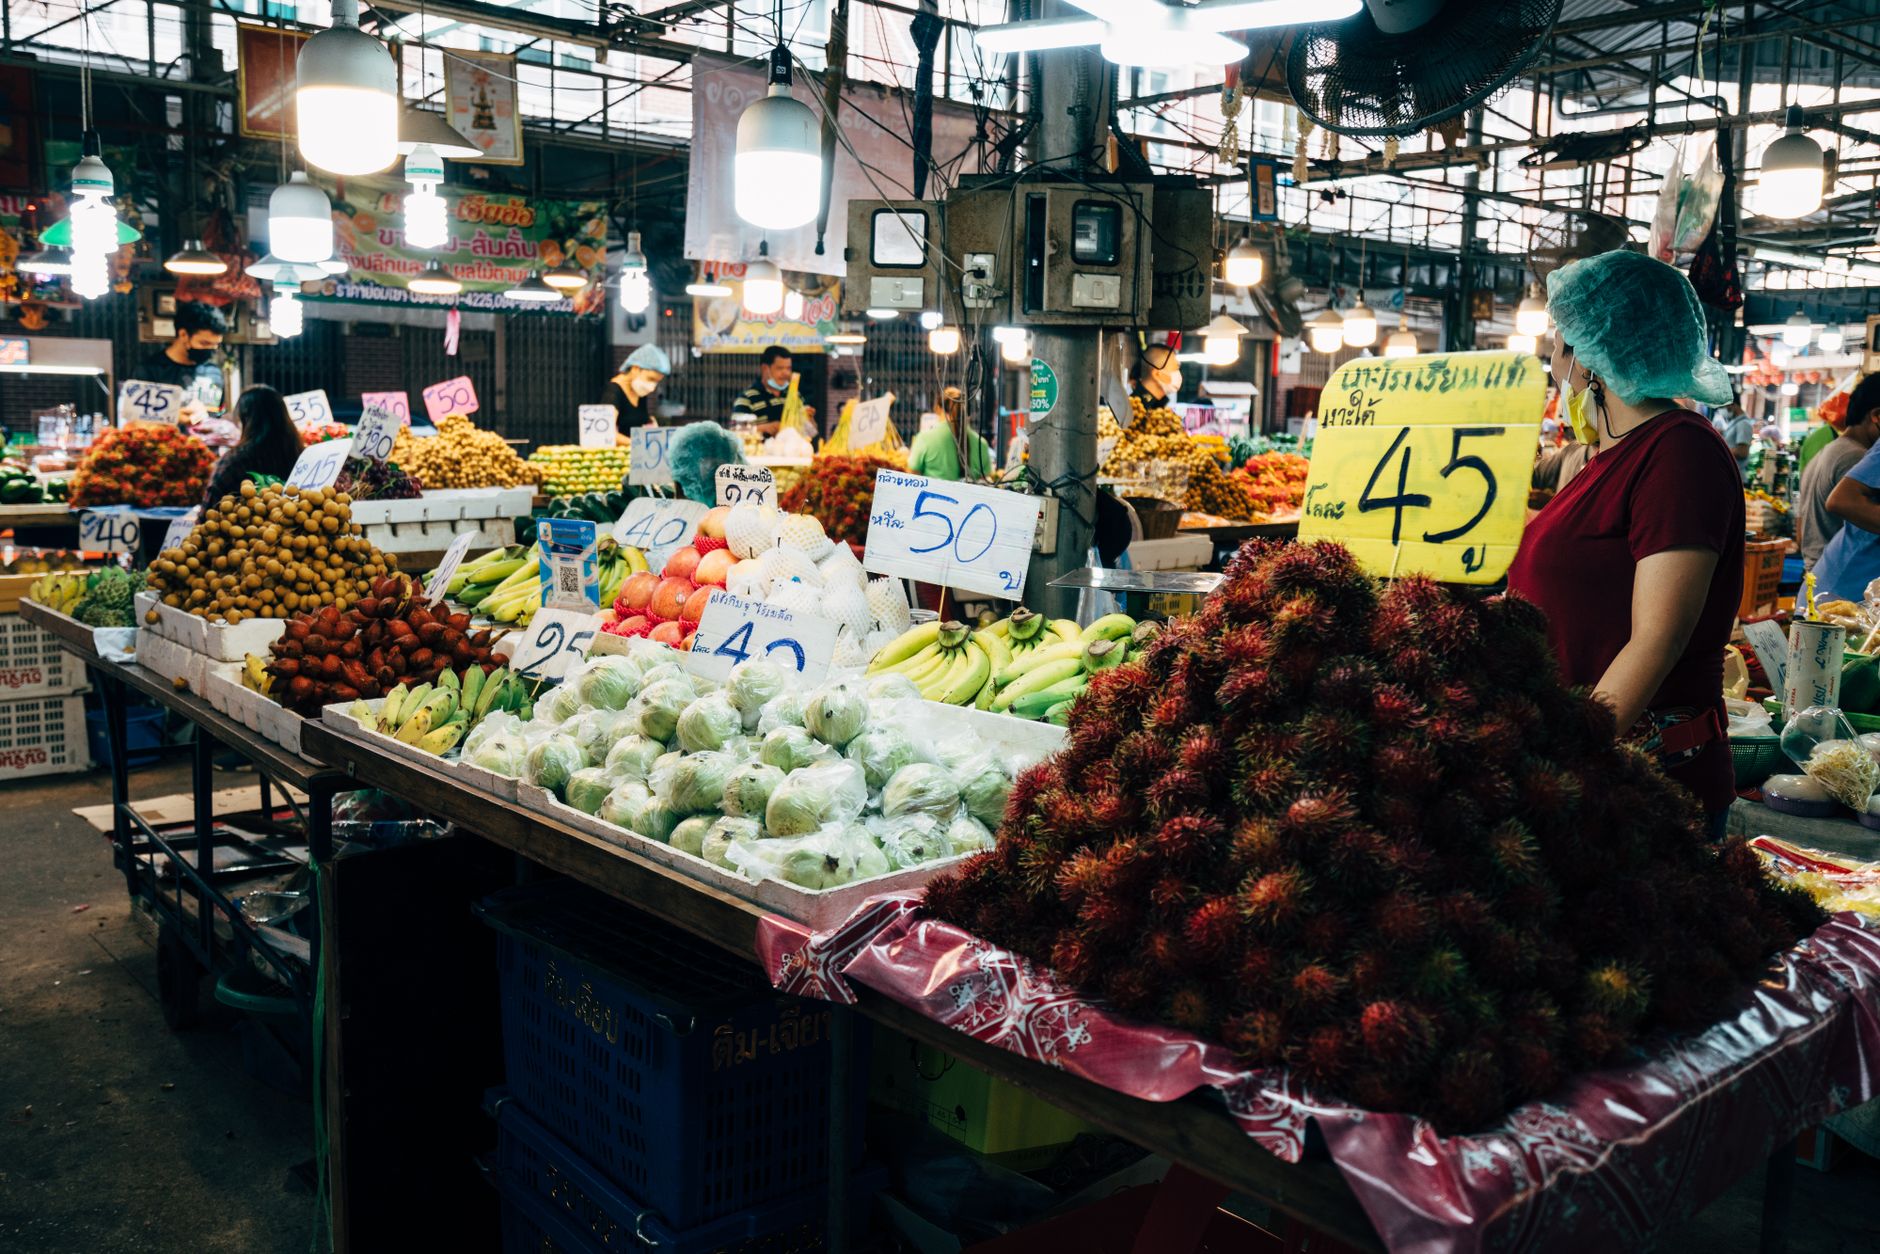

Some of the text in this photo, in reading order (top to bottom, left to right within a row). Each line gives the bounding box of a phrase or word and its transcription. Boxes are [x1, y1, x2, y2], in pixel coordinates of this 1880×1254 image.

[133, 389, 174, 415] 45
[289, 396, 326, 422] 35
[437, 387, 470, 414] 50
[583, 417, 609, 433] 70
[360, 430, 393, 458] 120
[878, 471, 929, 488] กล้วยหอม
[1358, 426, 1506, 546] 45
[95, 517, 139, 551] 40
[625, 512, 688, 547] 40
[909, 489, 997, 564] 50
